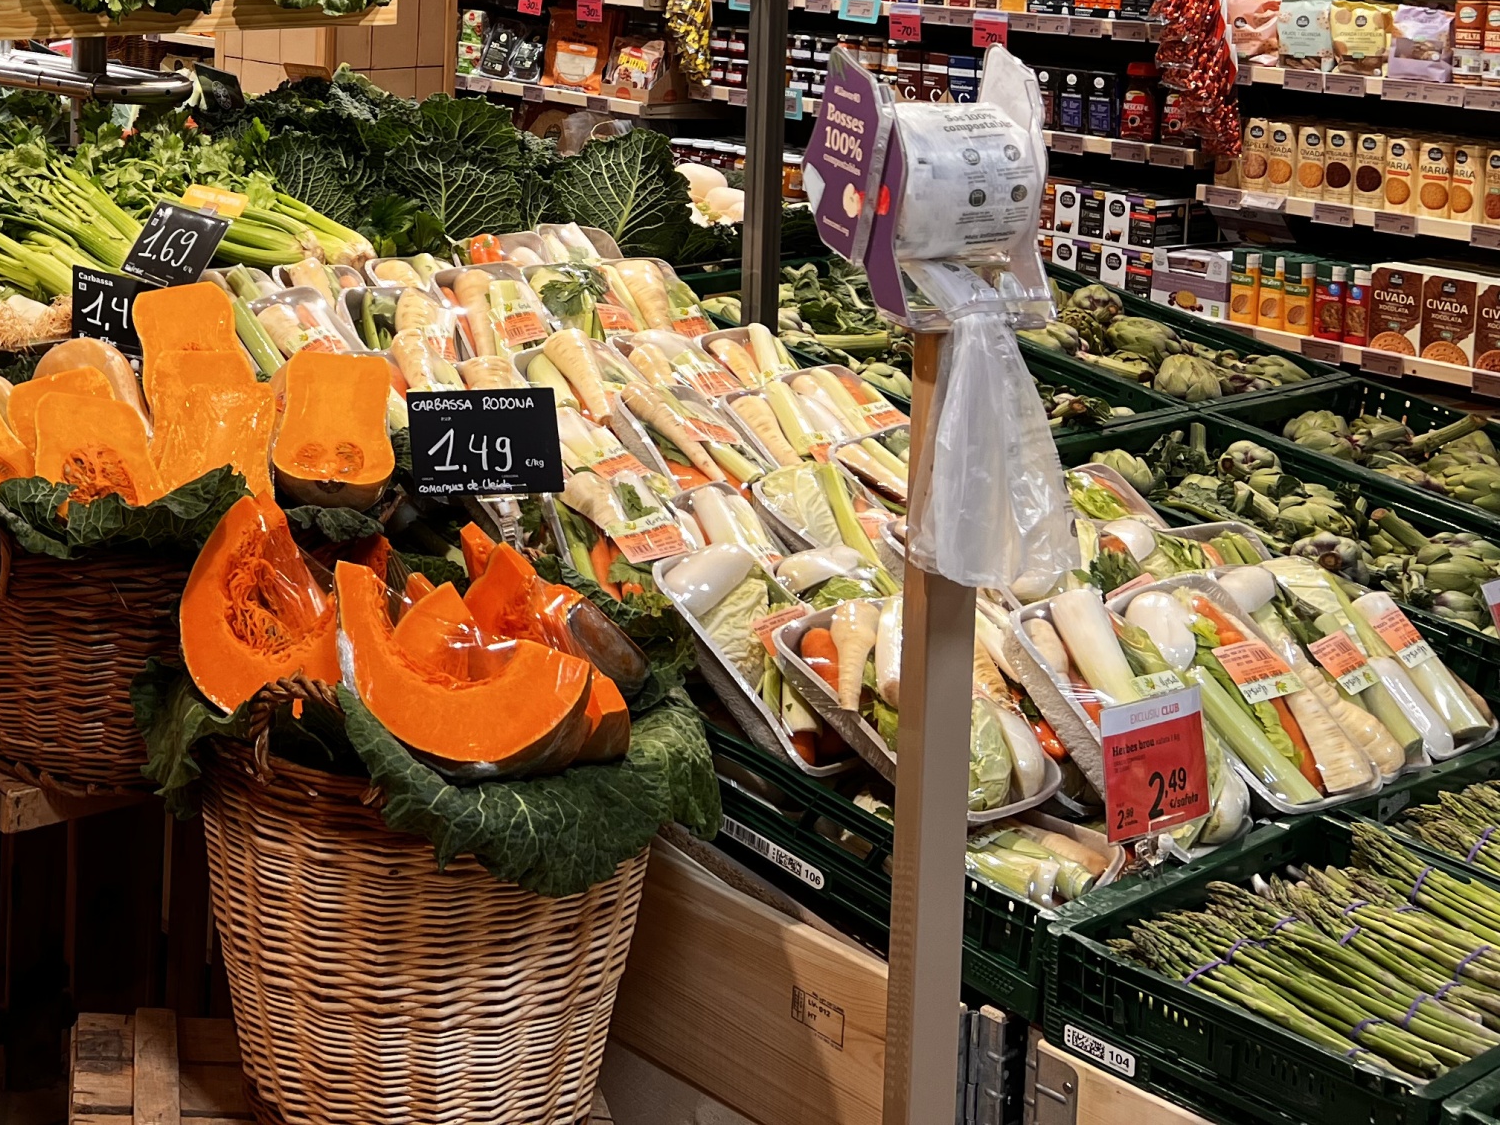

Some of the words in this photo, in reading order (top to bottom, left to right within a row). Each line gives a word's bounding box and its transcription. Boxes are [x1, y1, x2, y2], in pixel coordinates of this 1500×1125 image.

[827, 102, 865, 135] Bosses
[825, 126, 863, 162] 100%
[1421, 165, 1450, 175] MARIA
[1454, 169, 1476, 179] ARIA
[78, 271, 114, 287] Carbassa
[1373, 289, 1415, 306] CIVADA
[81, 291, 129, 331] 1,4
[1379, 304, 1409, 314] XOCOLATA
[1426, 298, 1469, 315] CIVADA
[1482, 307, 1500, 320] CIV
[1431, 313, 1462, 324] XOCOLATA
[411, 397, 473, 412] CARBASSA
[482, 396, 535, 411] RODONA
[467, 479, 479, 491] de
[1130, 710, 1160, 725] EXCLUSIU
[1161, 703, 1180, 716] CLUB
[1112, 742, 1138, 757] Herbes
[1138, 739, 1155, 751] brou
[1148, 766, 1188, 820] 2,49
[804, 868, 821, 886] 106
[1108, 1050, 1130, 1069] 104
